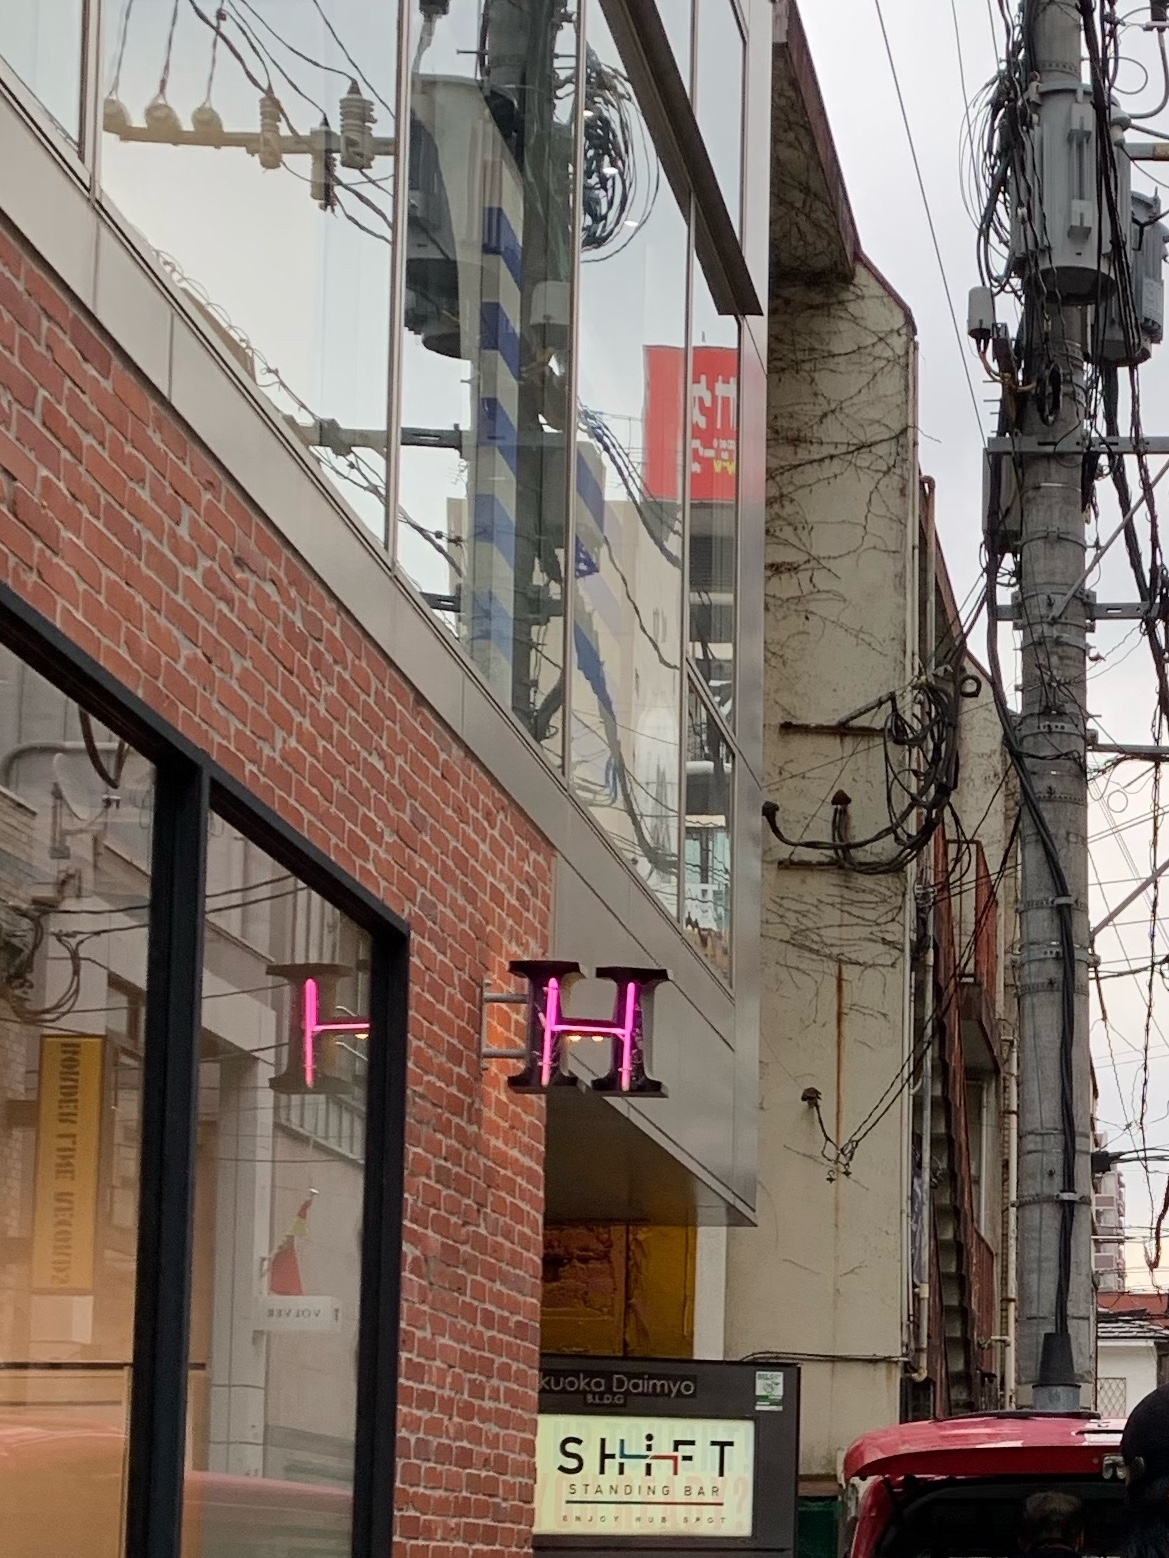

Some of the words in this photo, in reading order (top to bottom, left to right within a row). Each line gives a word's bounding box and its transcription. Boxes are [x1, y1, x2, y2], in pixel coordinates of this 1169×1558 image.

[613, 1374, 695, 1397] Daimyo
[568, 1483, 670, 1496] STANDING
[684, 1485, 720, 1497] BAR
